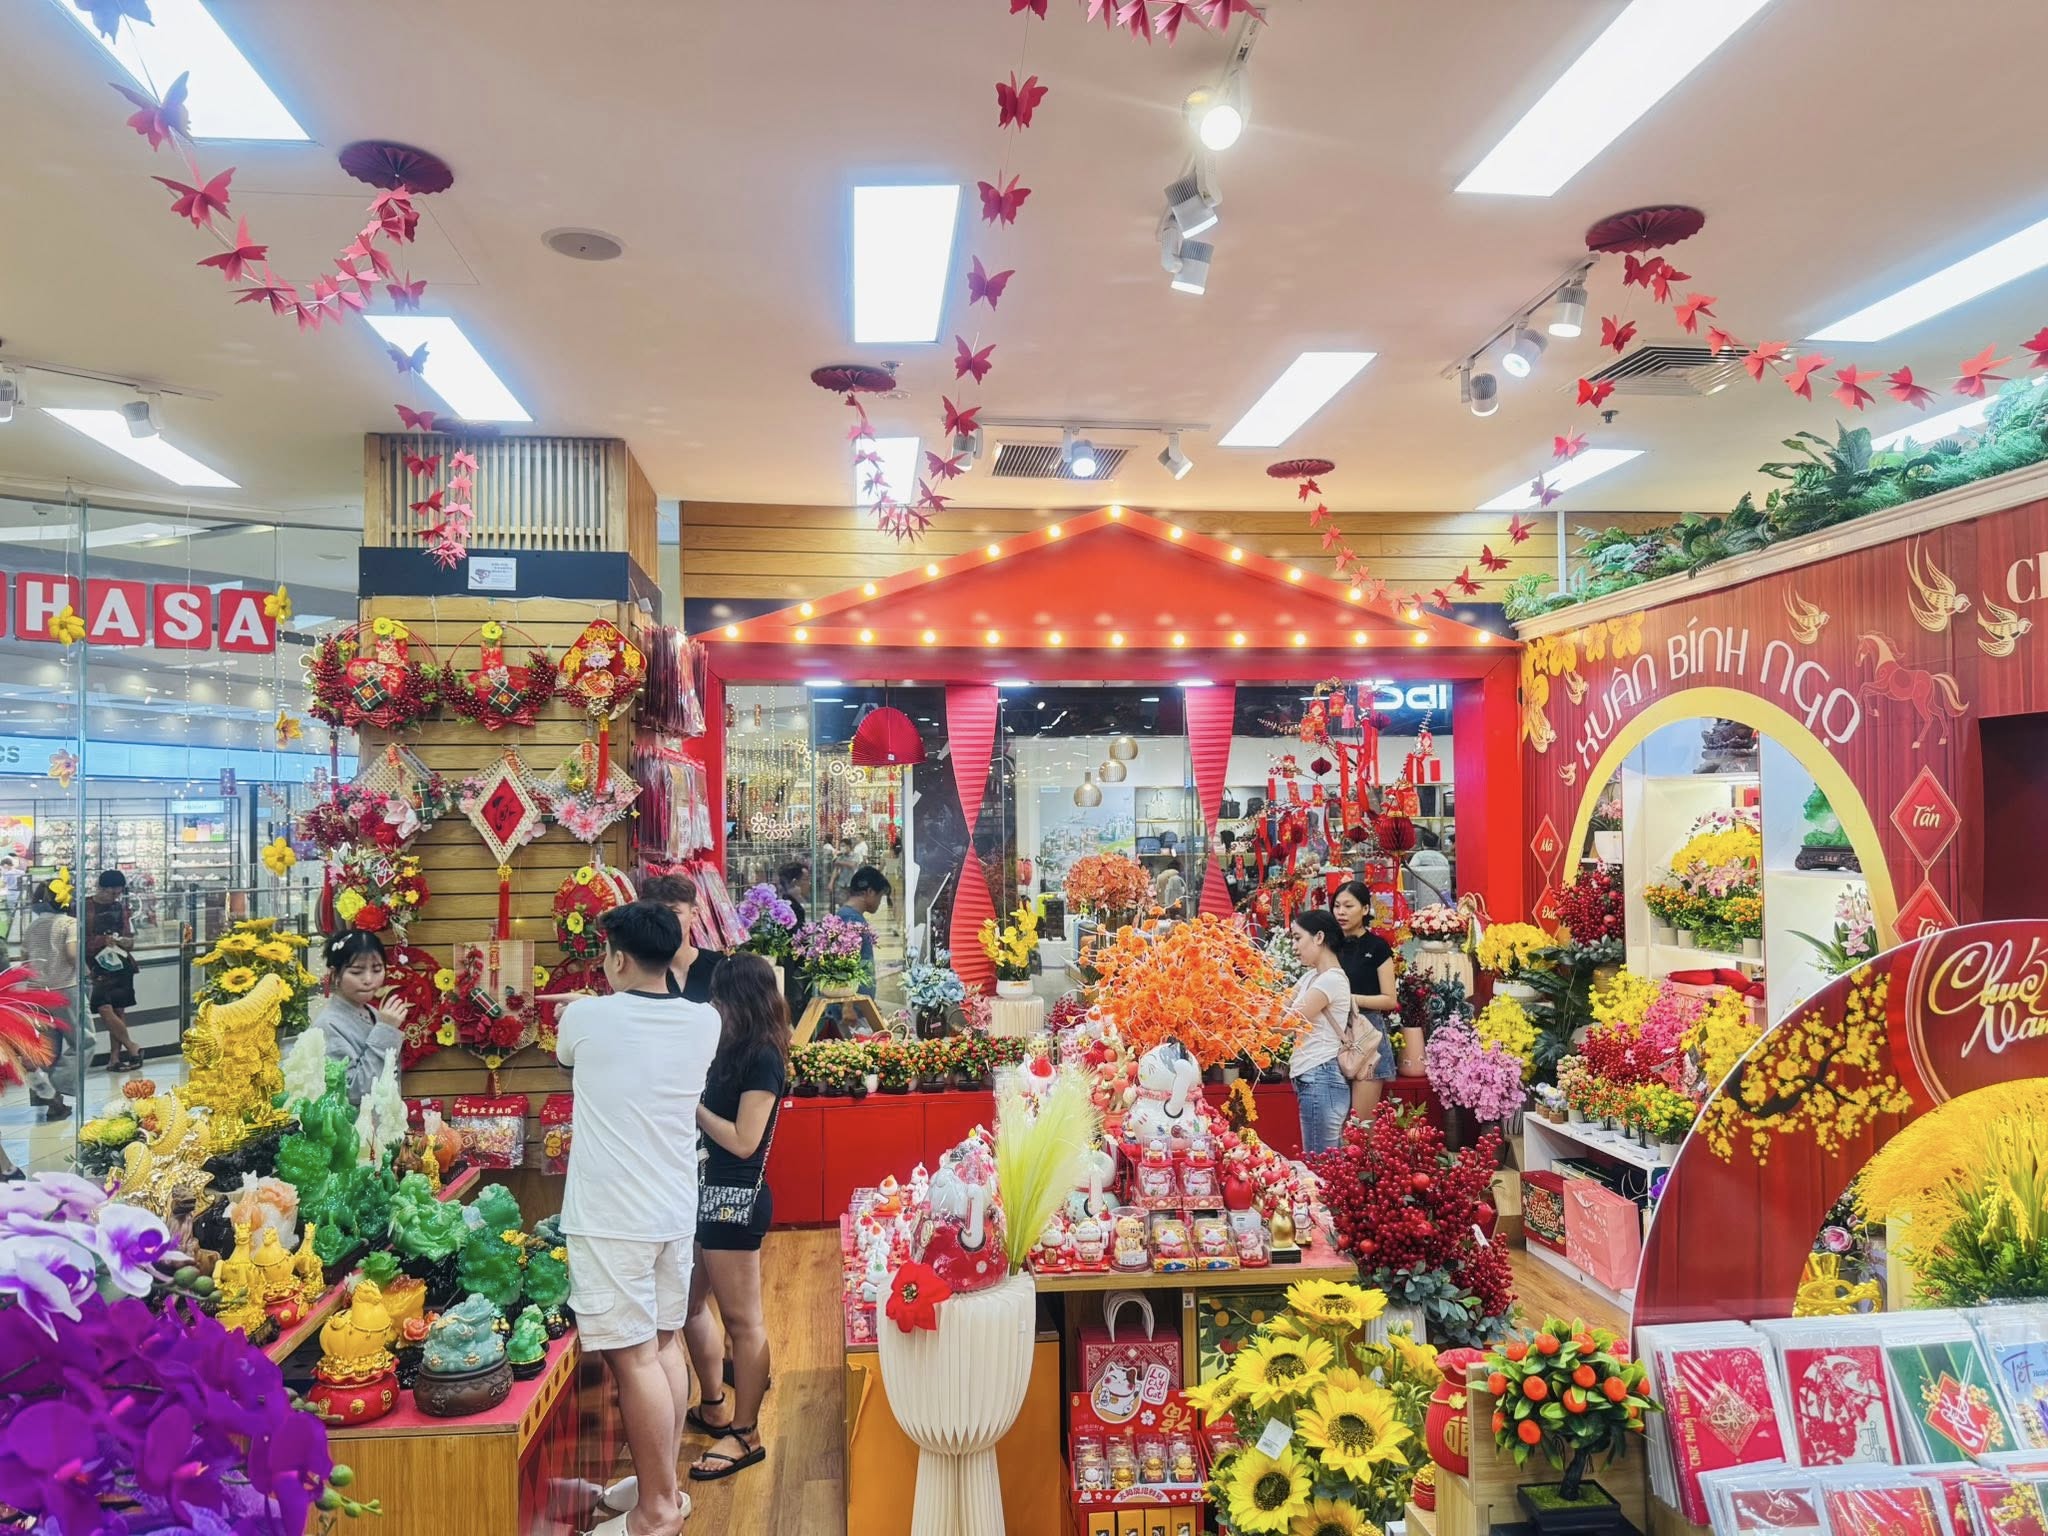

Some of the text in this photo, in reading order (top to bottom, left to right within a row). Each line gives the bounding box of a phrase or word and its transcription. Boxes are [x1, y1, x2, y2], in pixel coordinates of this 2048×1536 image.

[1576, 616, 1861, 770] XUÂN BÍNH NGỌ
[1912, 804, 1941, 829] Tấn
